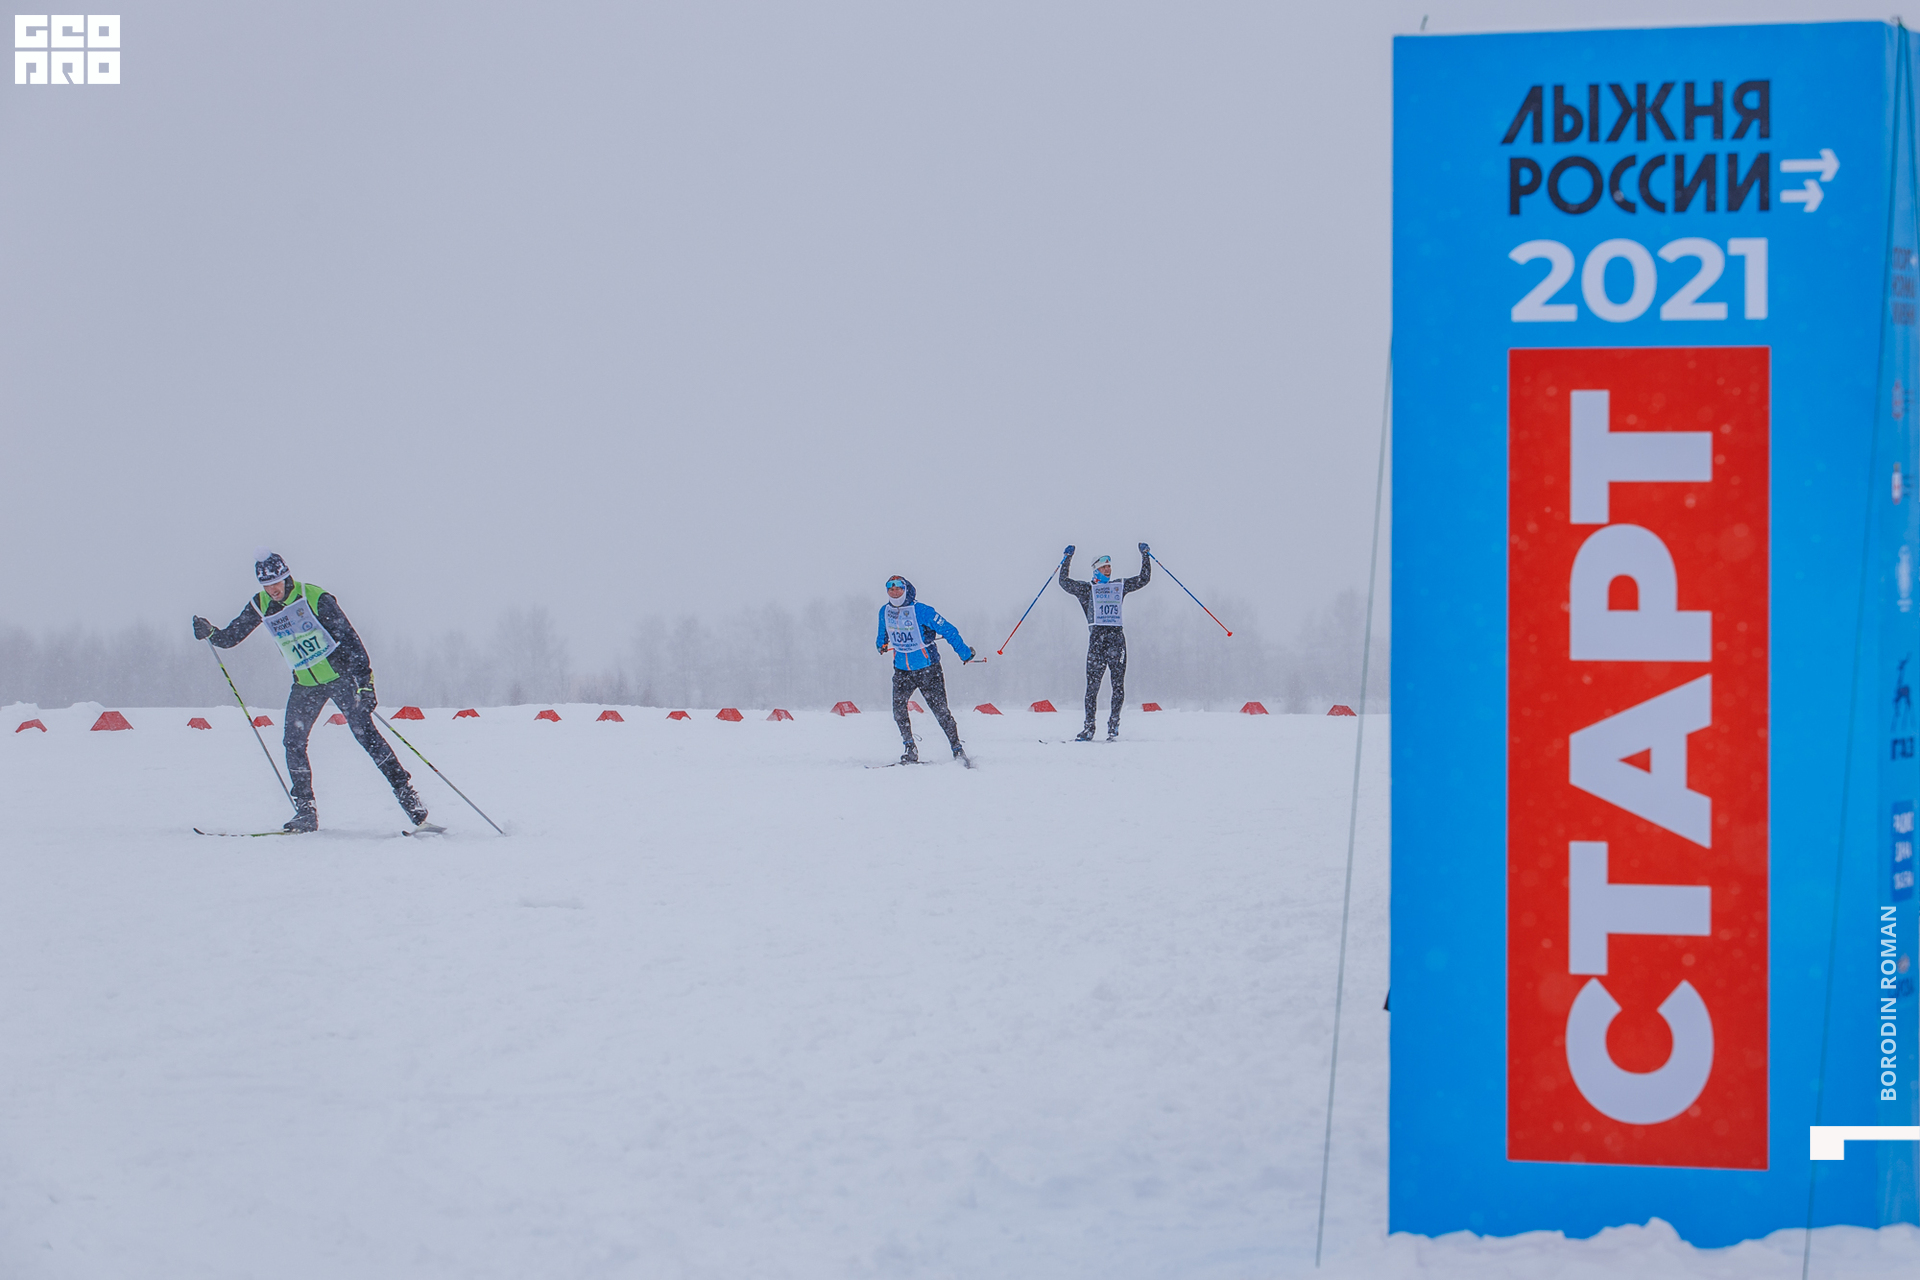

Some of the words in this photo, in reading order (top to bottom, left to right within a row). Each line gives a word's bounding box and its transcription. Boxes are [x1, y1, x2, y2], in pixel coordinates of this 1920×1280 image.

[1501, 80, 1771, 144] ЛЫЖНЯ
[1509, 152, 1771, 215] РОССИИ
[1509, 237, 1769, 322] 2021
[291, 635, 321, 659] 1197
[891, 631, 914, 643] 1304
[1566, 390, 1713, 1125] СТАРТ
